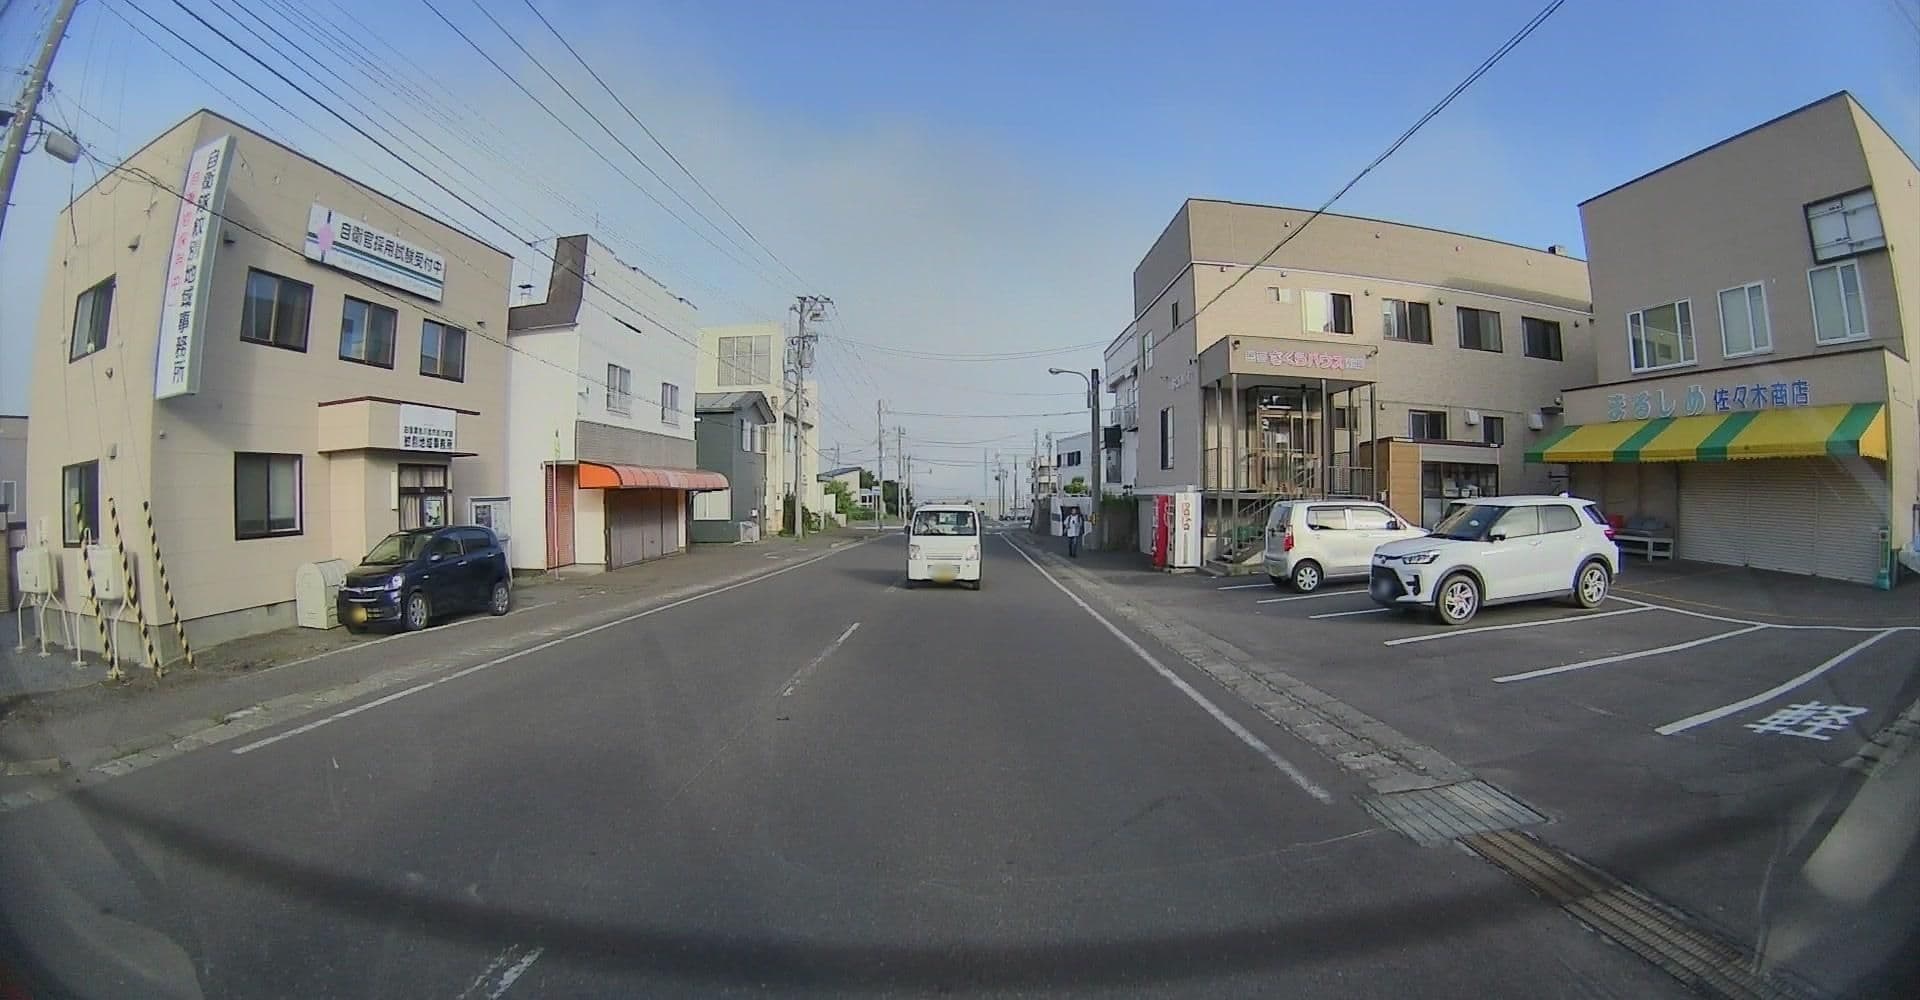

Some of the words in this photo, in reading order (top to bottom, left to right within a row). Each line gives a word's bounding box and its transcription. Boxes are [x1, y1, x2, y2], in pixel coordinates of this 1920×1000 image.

[340, 222, 443, 274] 自衛官採用試験受付中
[1608, 385, 1706, 422] まるしめ
[1713, 379, 1810, 412] 佐々木商店
[1743, 701, 1868, 740] 軽
